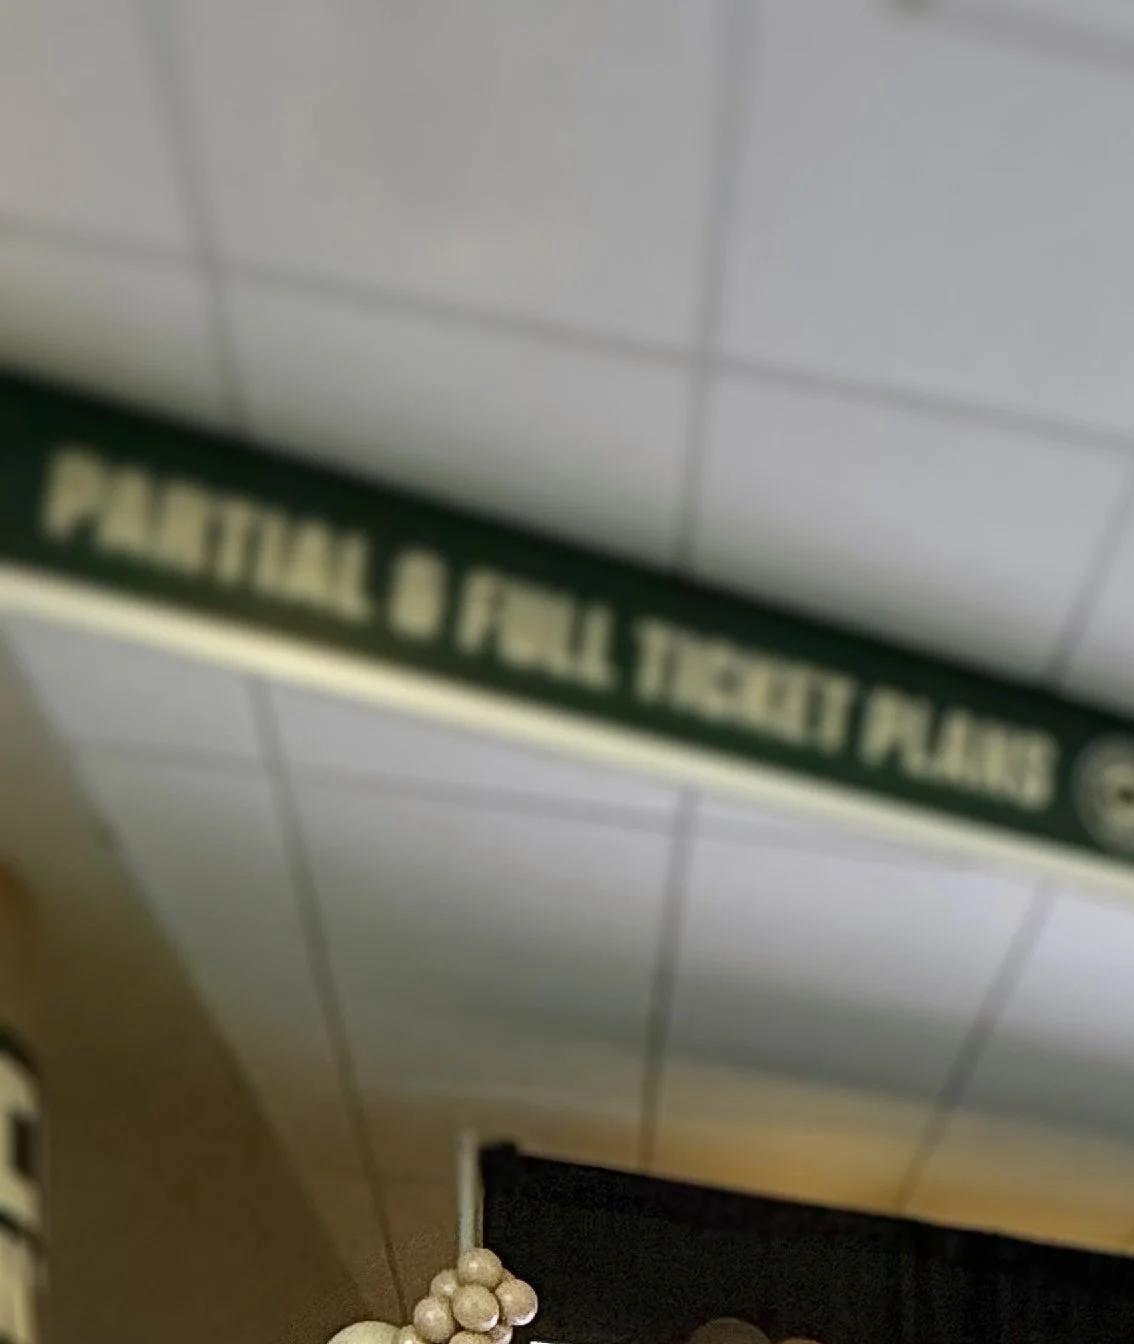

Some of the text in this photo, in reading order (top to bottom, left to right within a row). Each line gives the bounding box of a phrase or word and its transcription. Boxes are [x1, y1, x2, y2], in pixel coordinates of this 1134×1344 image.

[42, 447, 372, 627] PARTIAL
[455, 568, 618, 692] FULL
[634, 615, 852, 758] TICKET
[860, 686, 1058, 812] PLANS
